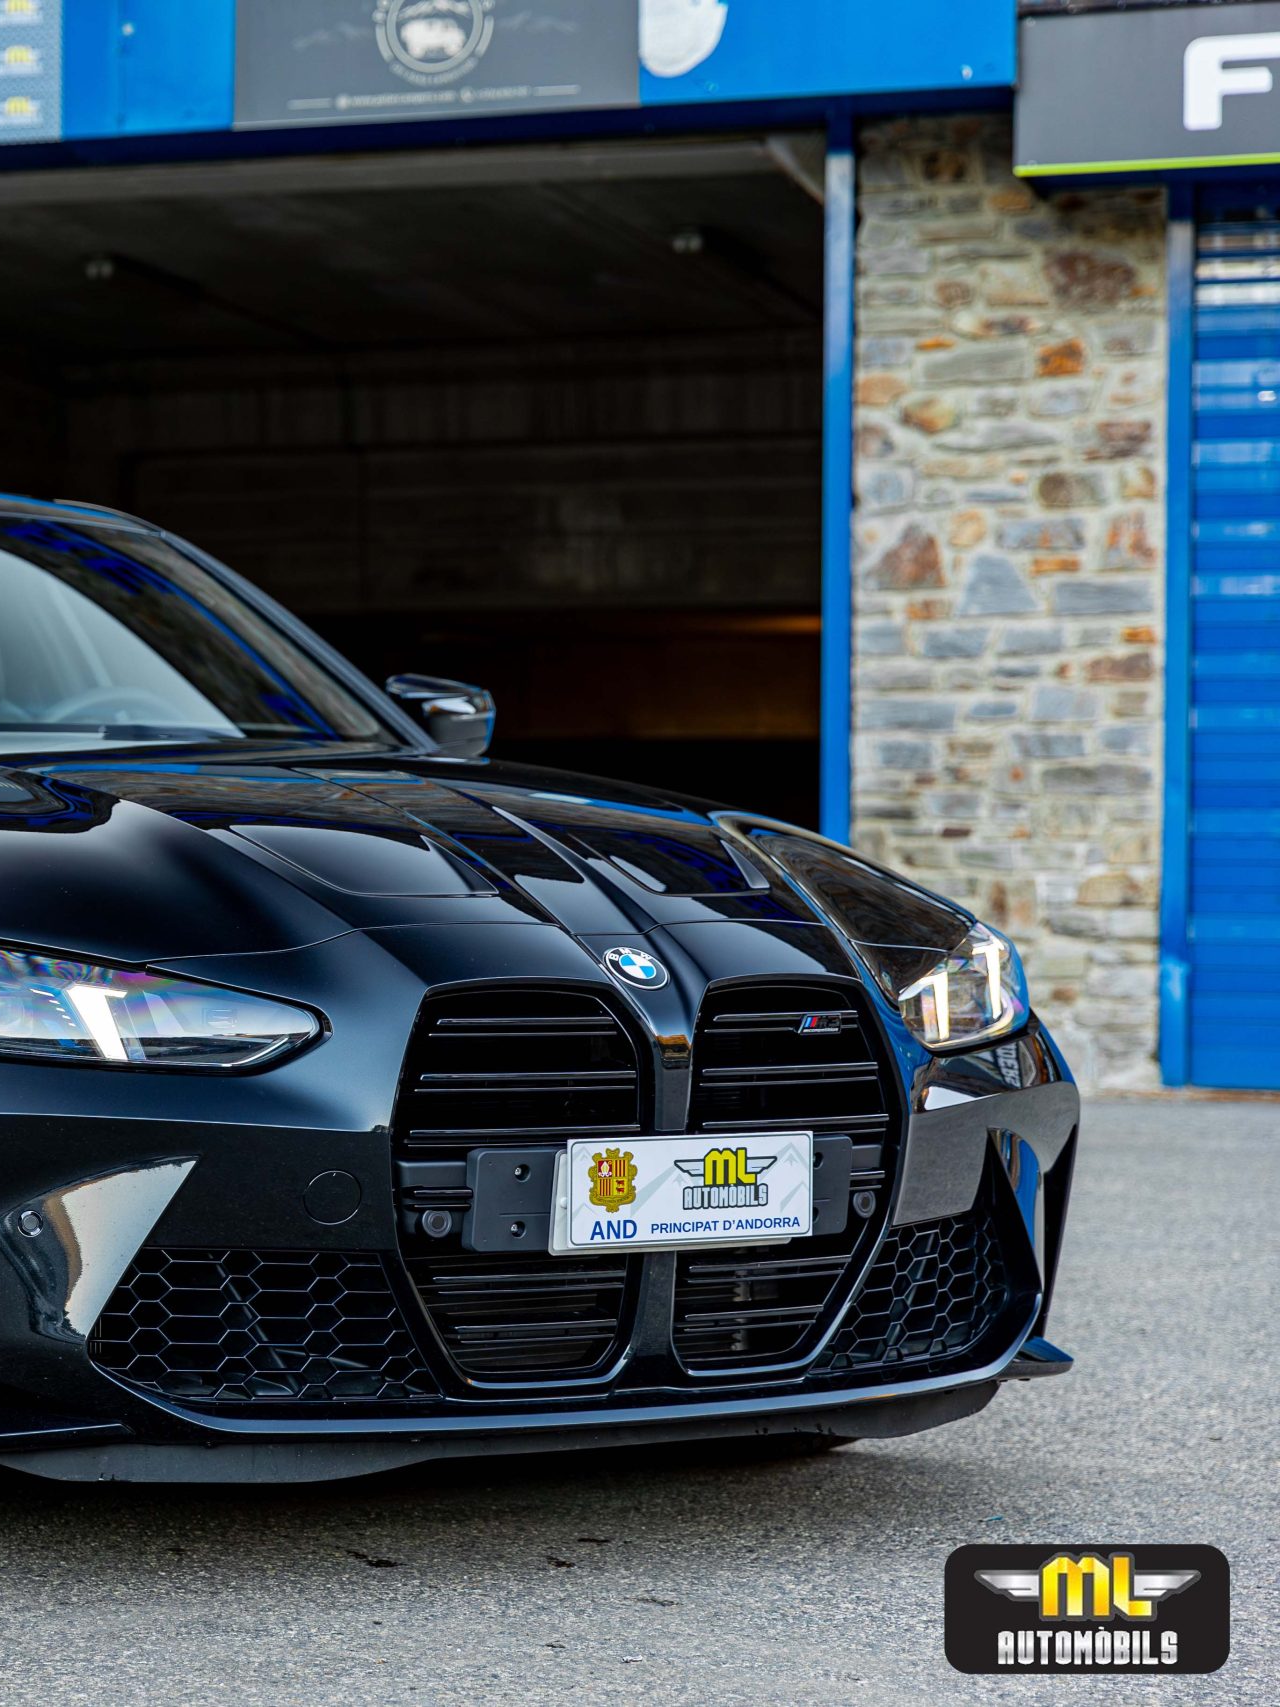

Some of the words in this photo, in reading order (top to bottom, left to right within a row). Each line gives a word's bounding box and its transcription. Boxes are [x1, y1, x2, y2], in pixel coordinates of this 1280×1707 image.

[704, 1147, 756, 1185] ML
[683, 1184, 768, 1210] AUTOMÒBILS
[590, 1219, 638, 1241] AND
[651, 1220, 719, 1234] PRINCIPAT
[723, 1217, 801, 1231] D'ANDORRA
